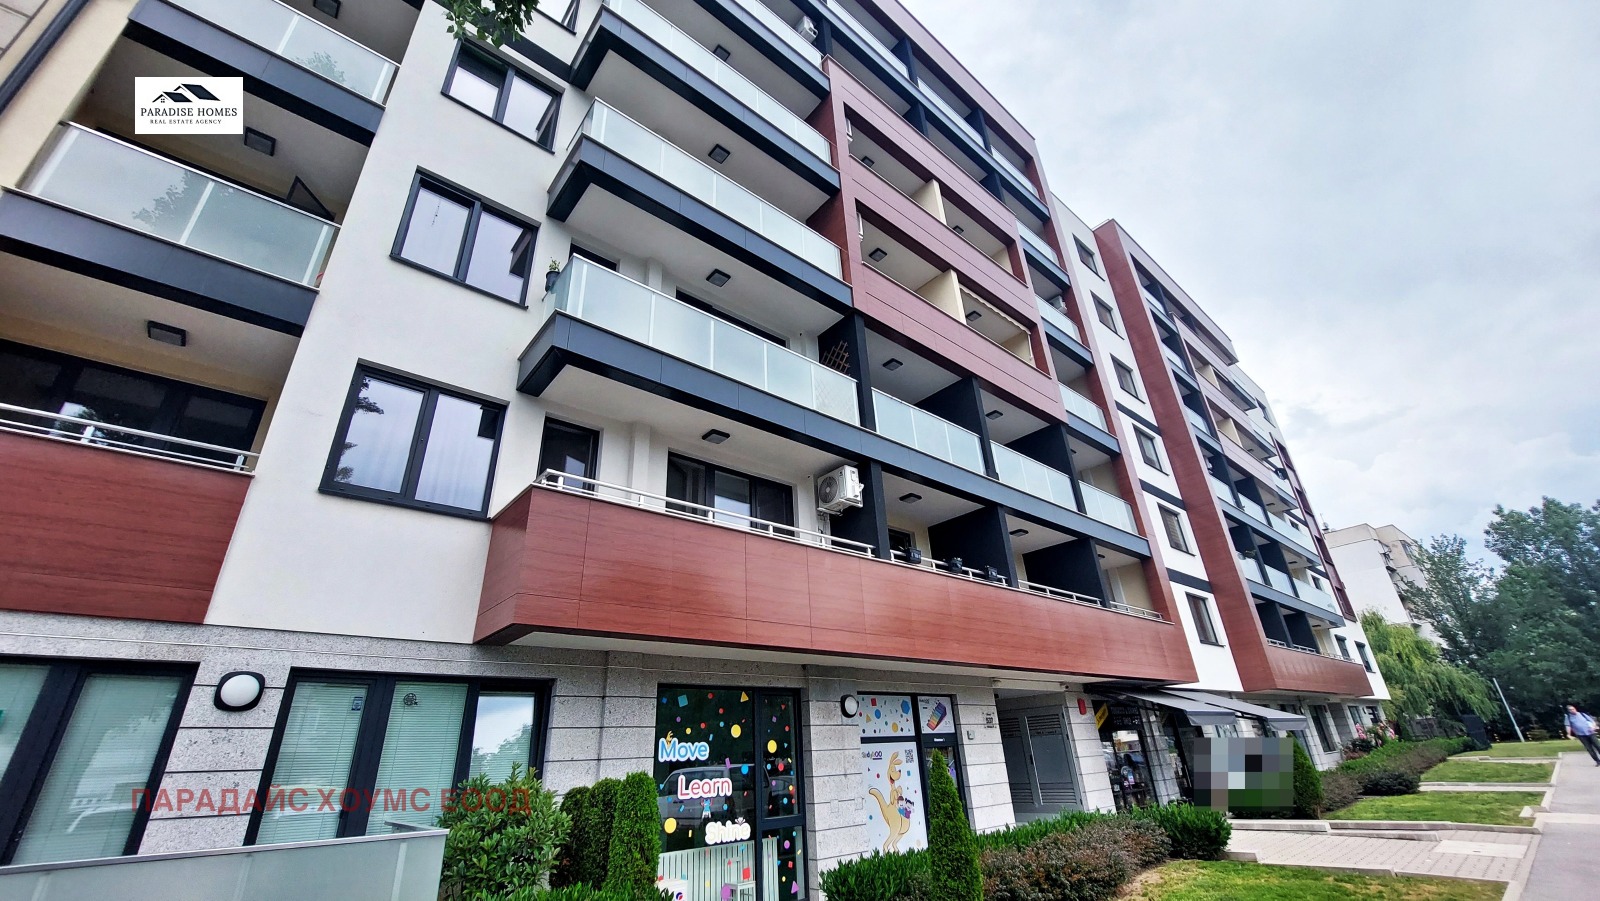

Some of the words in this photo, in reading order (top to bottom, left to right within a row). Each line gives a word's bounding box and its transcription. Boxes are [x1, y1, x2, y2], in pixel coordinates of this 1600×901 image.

[659, 739, 709, 761] Move
[679, 776, 732, 798] Learn
[705, 821, 751, 844] Shine
